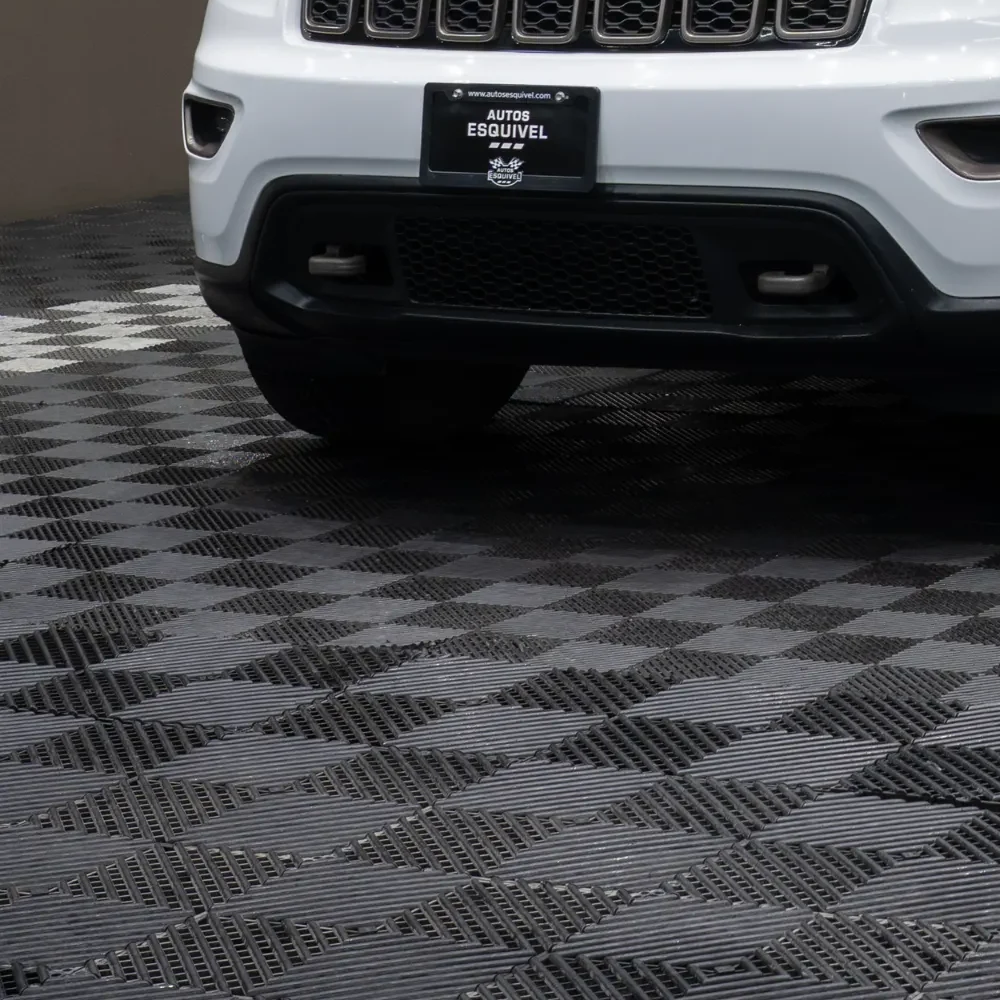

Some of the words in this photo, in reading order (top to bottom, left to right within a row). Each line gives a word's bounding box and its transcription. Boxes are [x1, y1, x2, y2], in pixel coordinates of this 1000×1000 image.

[467, 91, 552, 100] www.autosesquivel.com
[487, 109, 530, 122] AUTOS
[467, 122, 548, 139] ESQUIVEL
